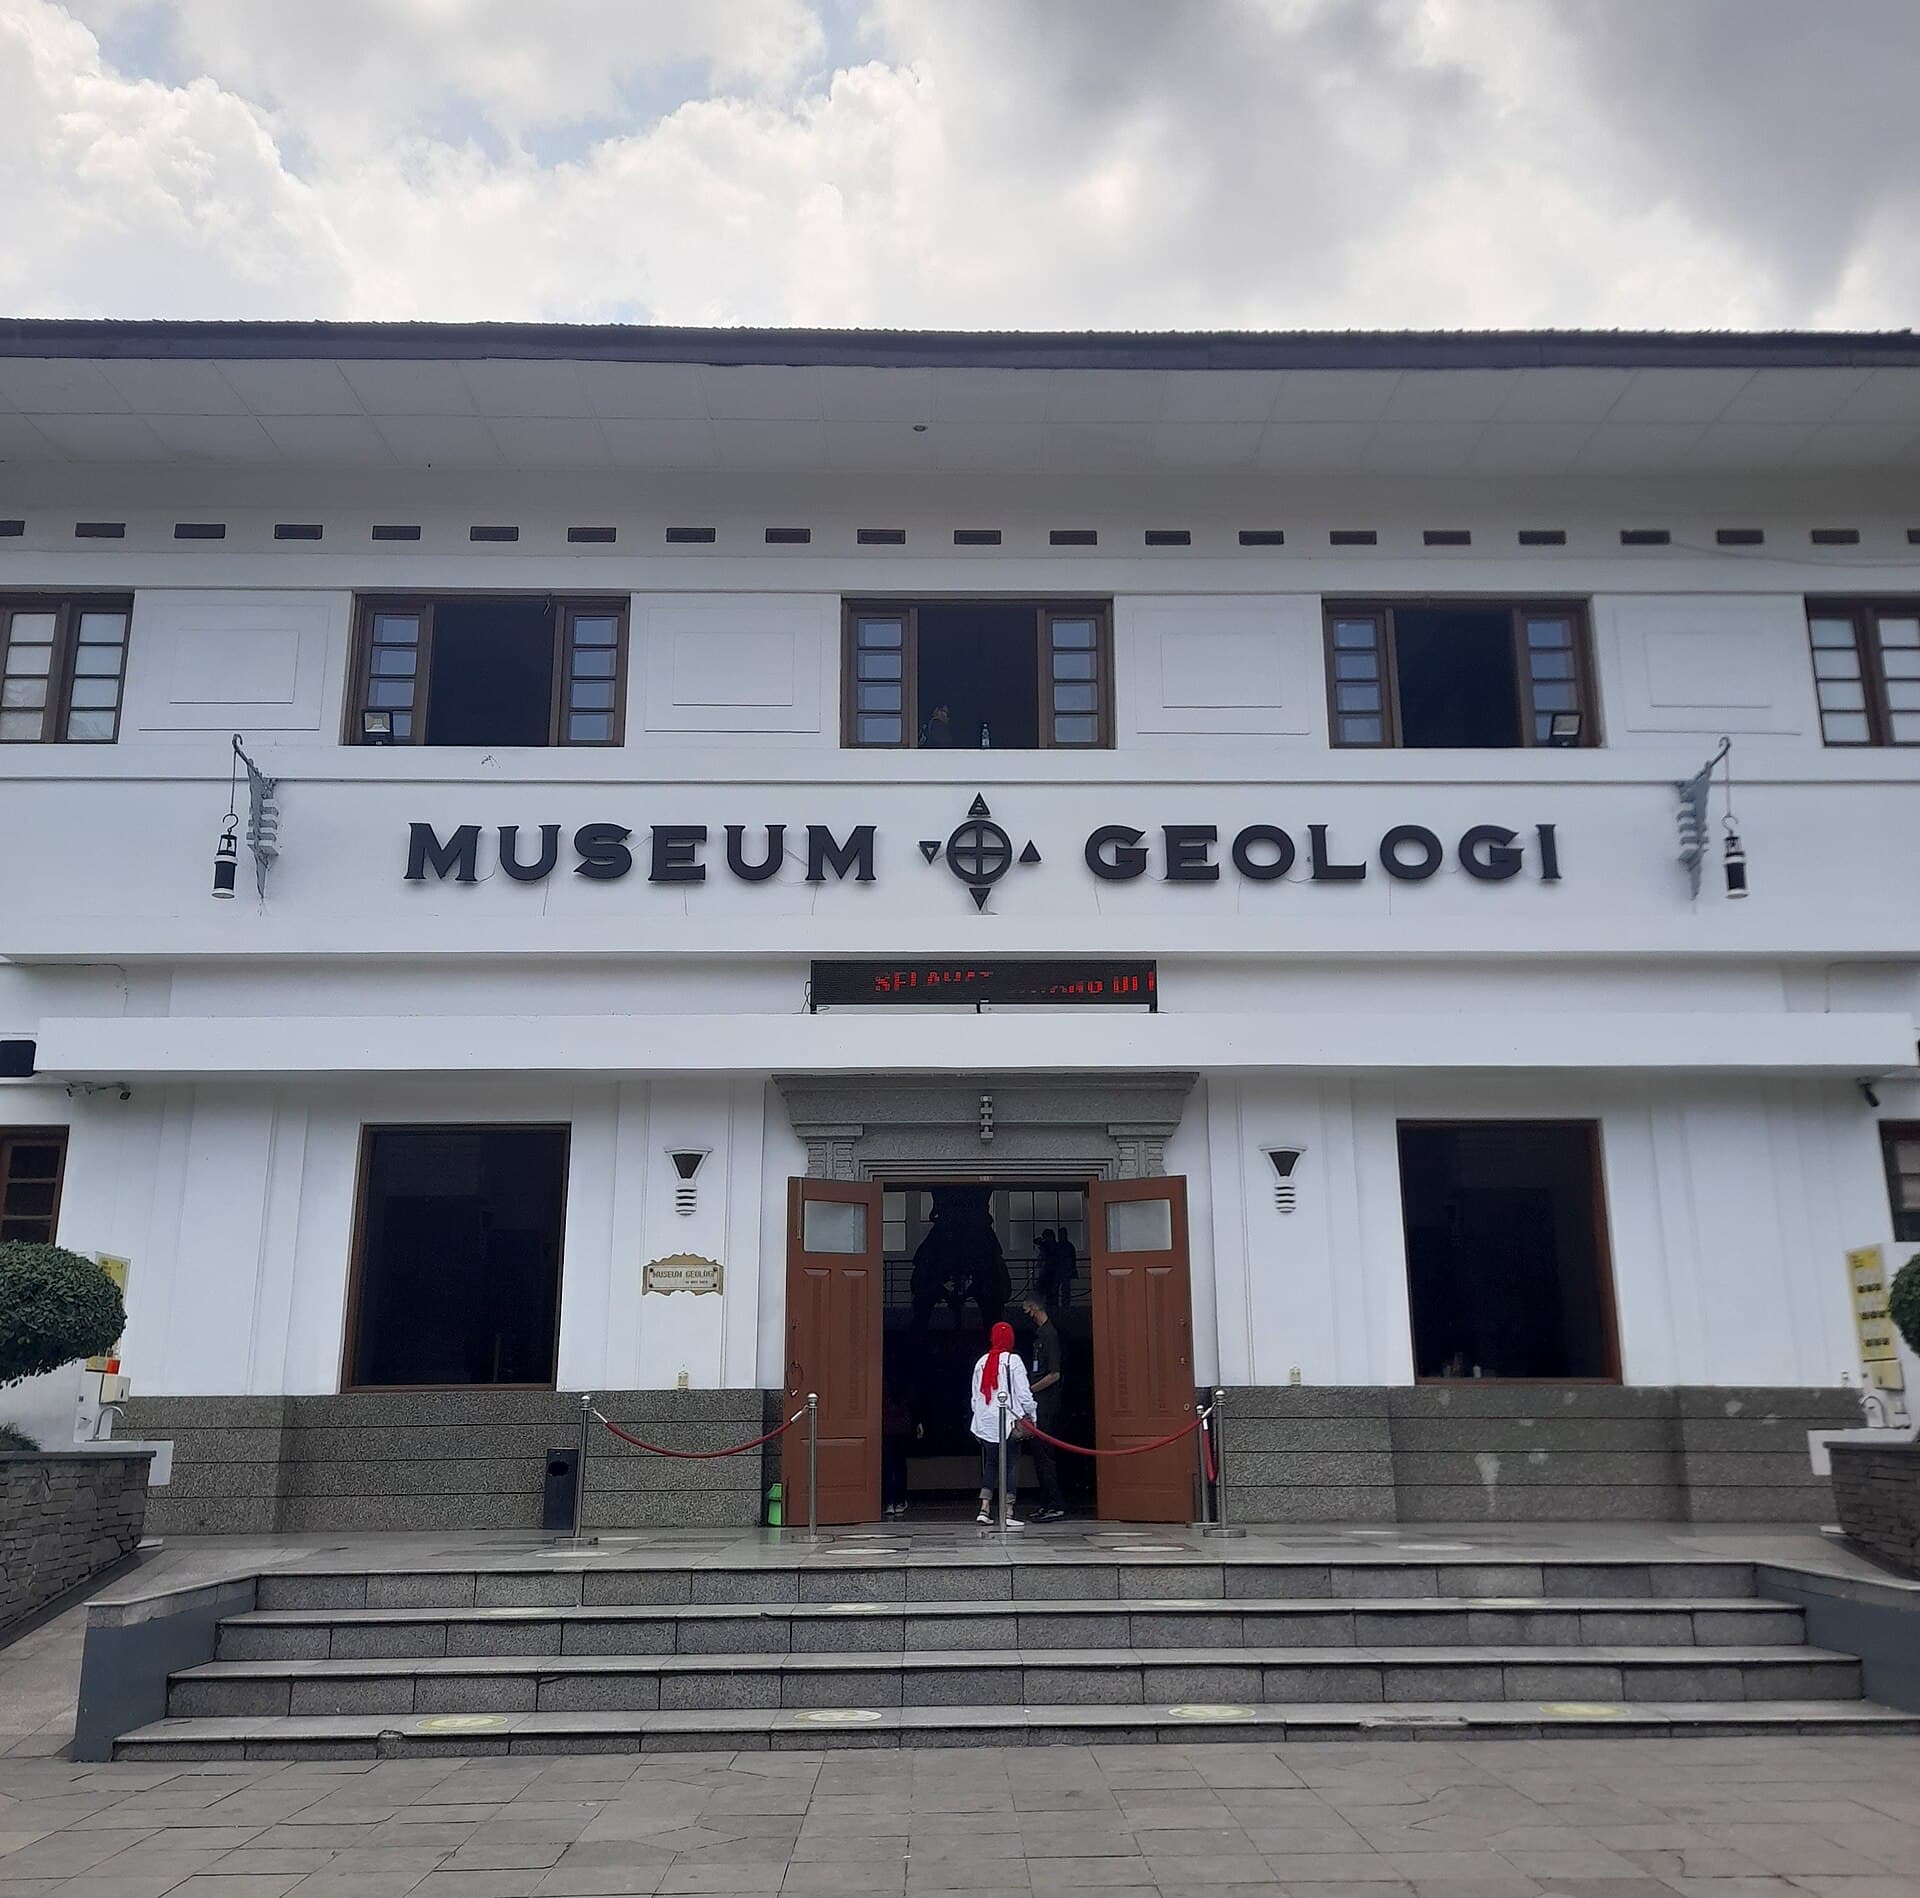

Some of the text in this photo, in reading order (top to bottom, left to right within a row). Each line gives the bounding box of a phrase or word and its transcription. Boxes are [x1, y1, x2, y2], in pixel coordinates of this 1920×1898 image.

[404, 822, 1562, 886] MUSEUM GEOLOGI
[652, 1270, 683, 1279] MUSEUM
